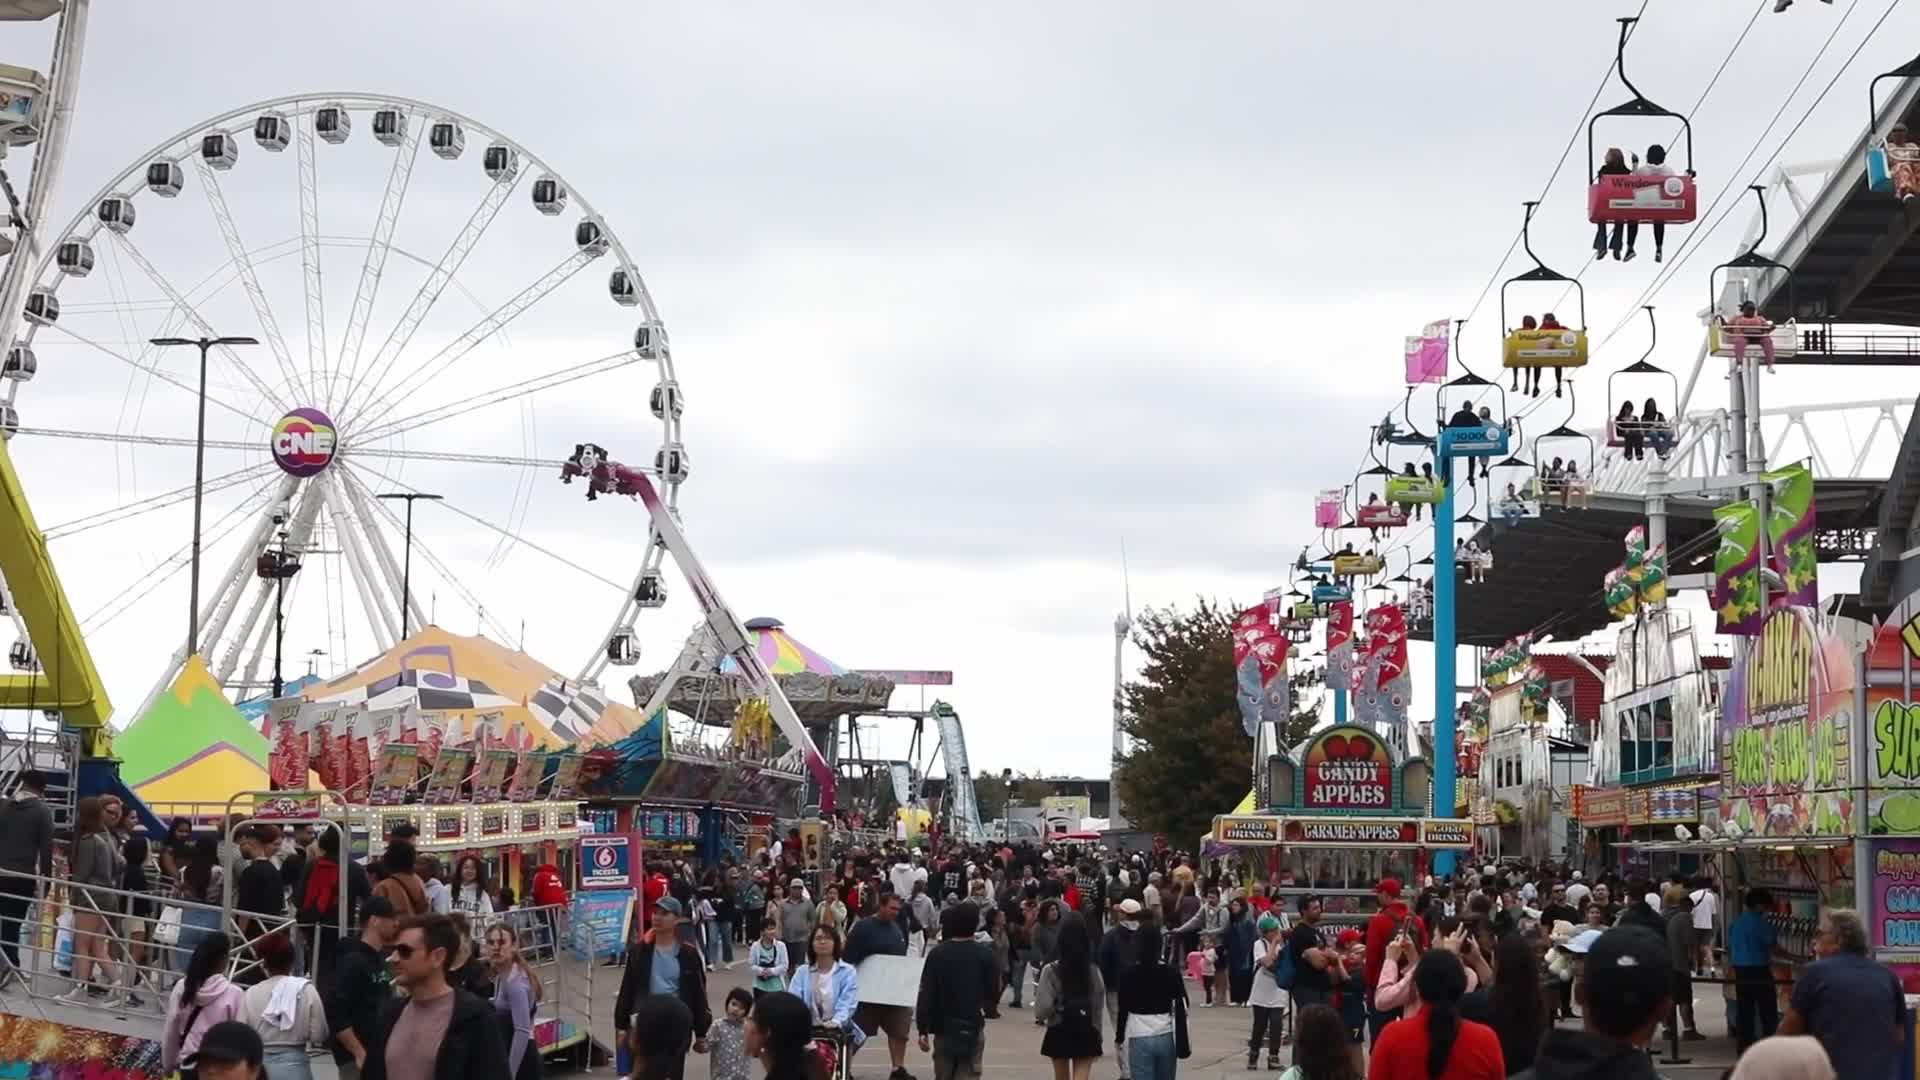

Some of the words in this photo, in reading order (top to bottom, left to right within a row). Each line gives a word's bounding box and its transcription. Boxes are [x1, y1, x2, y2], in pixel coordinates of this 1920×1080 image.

[274, 432, 332, 455] CNE
[1318, 761, 1380, 782] CANDY
[1312, 783, 1385, 804] APPLES
[1227, 830, 1274, 839] DRINKS
[1304, 824, 1356, 840] CARAMEL
[1357, 824, 1400, 840] APPLES
[1428, 833, 1468, 842] DRINKS
[598, 847, 612, 867] 6
